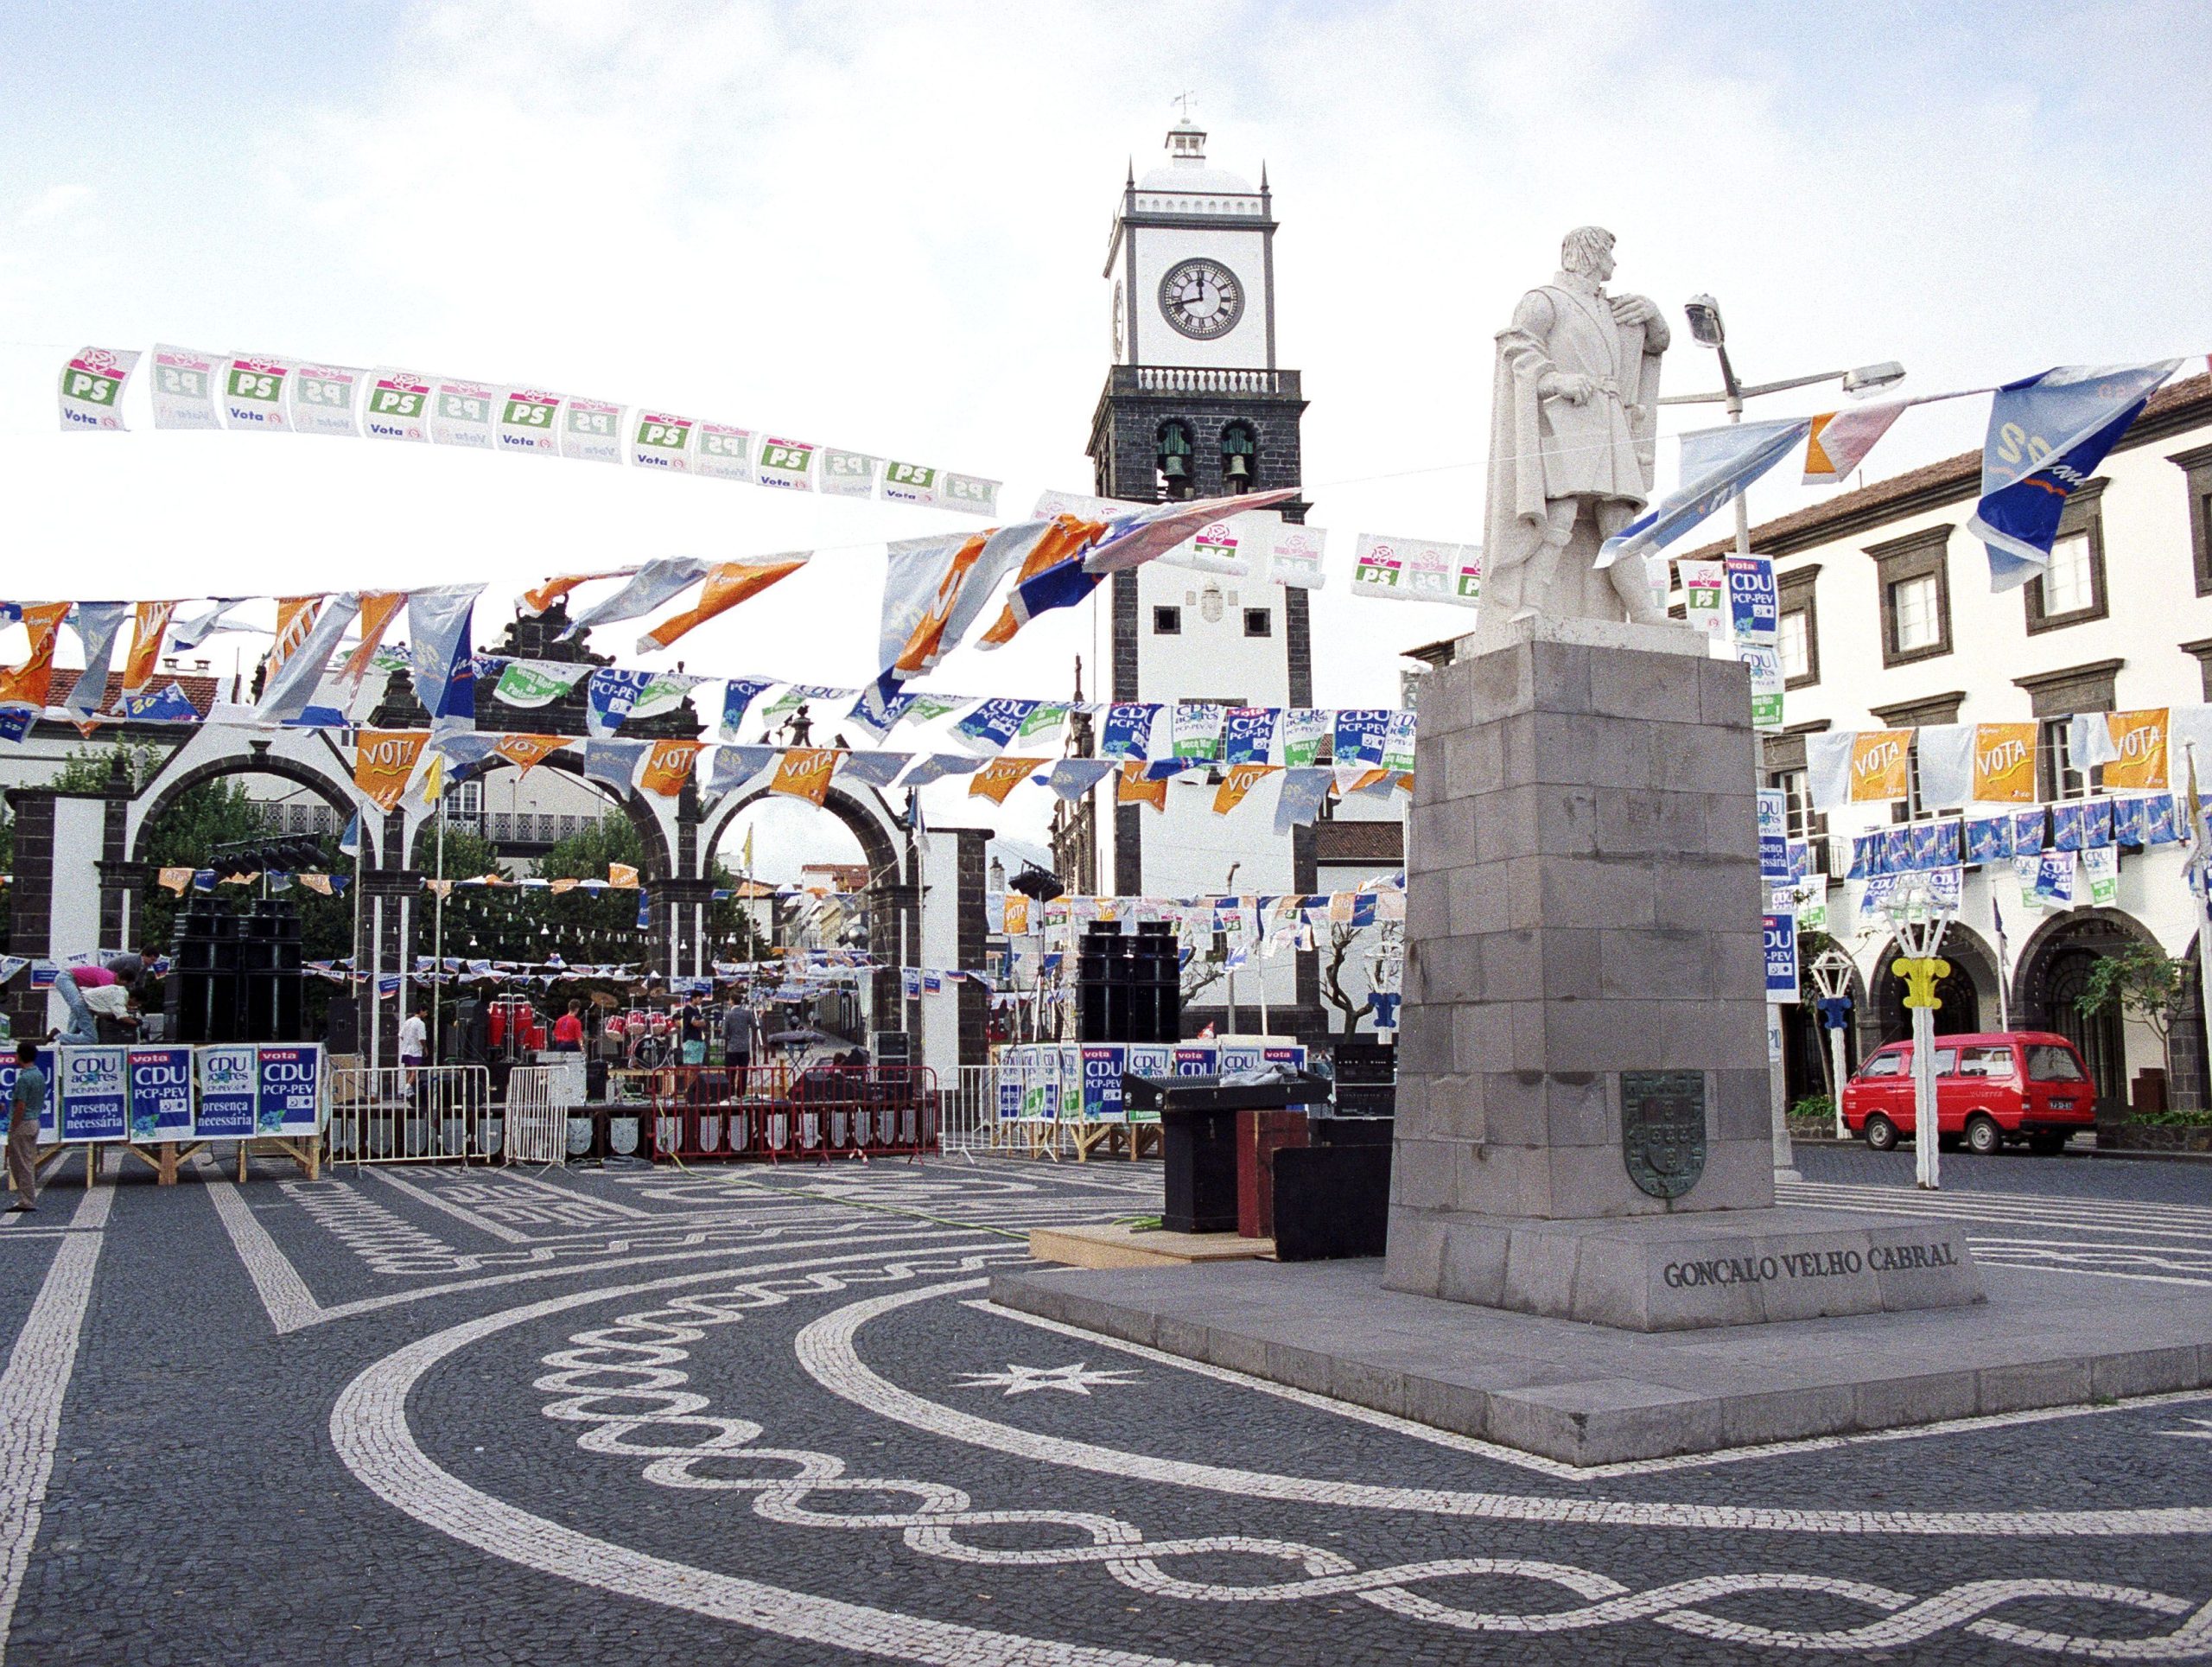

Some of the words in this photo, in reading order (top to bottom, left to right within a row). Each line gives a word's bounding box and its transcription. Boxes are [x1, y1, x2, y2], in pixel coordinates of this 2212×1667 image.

[71, 373, 111, 401] PS
[238, 373, 277, 399] PS
[379, 390, 416, 414] PS
[64, 407, 97, 425] Vota
[230, 407, 264, 422] Vota
[511, 404, 547, 424] PS
[371, 423, 404, 436] Vota
[646, 424, 681, 445] PS
[503, 435, 534, 447] Vota
[638, 454, 668, 467] Vota
[769, 448, 803, 469] PS
[761, 476, 791, 487] Vota
[894, 464, 928, 484] PS
[887, 489, 916, 500] Vota
[1728, 561, 1756, 570] vota
[1362, 569, 1391, 586] PS
[1731, 572, 1772, 593] CDU
[1696, 590, 1714, 607] PS
[1732, 592, 1774, 604] PCP-PEV
[1231, 714, 1277, 732] CDU
[1339, 709, 1389, 722] CDU
[783, 750, 833, 777] VOTA
[1854, 741, 1899, 778] VOTA
[1976, 739, 2026, 776] VOTA
[1759, 800, 1779, 815] DU
[2042, 861, 2072, 874] CDU
[1227, 921, 1240, 931] PS
[1764, 930, 1791, 949] DU
[1764, 951, 1793, 962] -PEV
[132, 1053, 168, 1064] vota
[262, 1051, 297, 1060] vota
[1133, 1056, 1162, 1068] CDU
[1224, 1055, 1254, 1068] CDU
[72, 1058, 116, 1074] CDU
[207, 1056, 246, 1072] CDU
[1085, 1061, 1122, 1077] CDU
[1179, 1061, 1215, 1076] CDU
[135, 1066, 187, 1085] CDU
[264, 1063, 315, 1082] CDU
[263, 1083, 314, 1095] PCP-PEV
[1085, 1078, 1122, 1088] PCP-PEV
[134, 1087, 187, 1099] PCP-PEV
[71, 1102, 118, 1117] presença
[202, 1100, 249, 1115] presença
[67, 1114, 123, 1129] necessária
[198, 1113, 252, 1127] necessária
[1664, 1256, 1778, 1289] GONÇALO
[1782, 1250, 1862, 1278] VELHO
[1867, 1243, 1959, 1272] CABRAL
